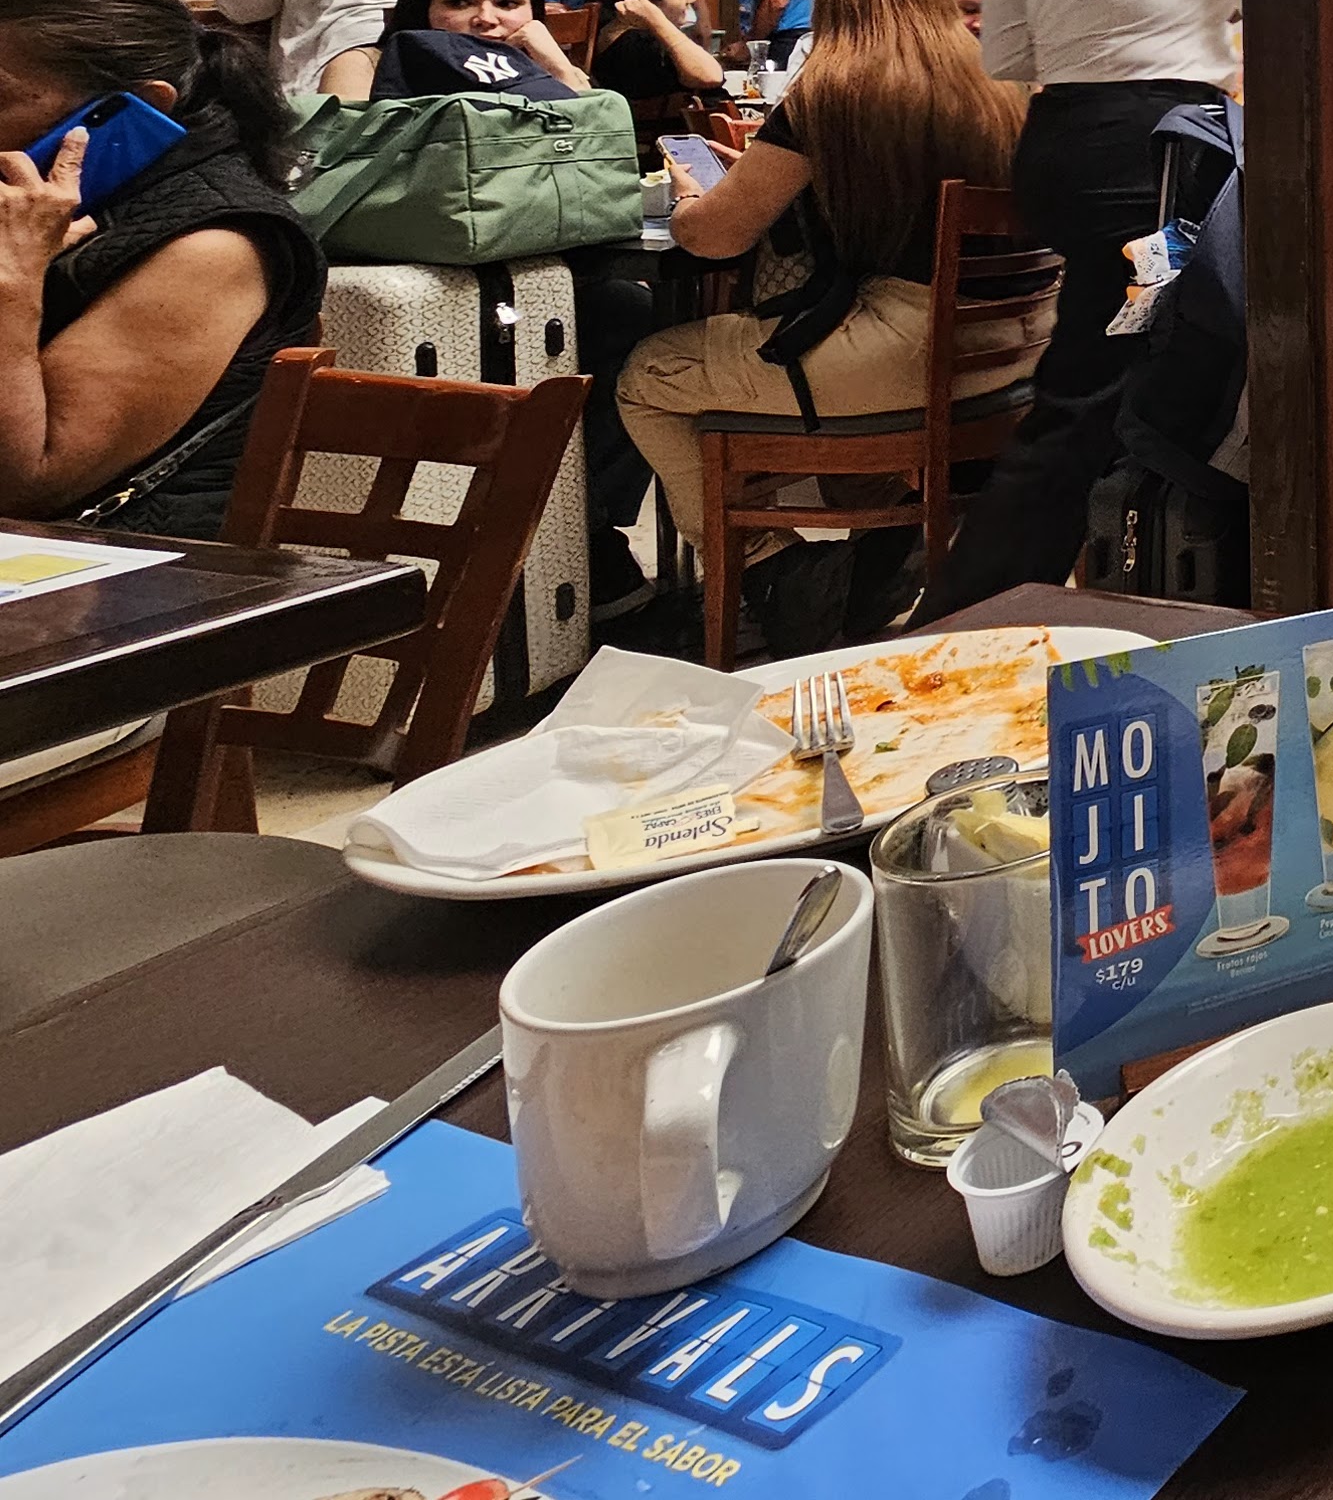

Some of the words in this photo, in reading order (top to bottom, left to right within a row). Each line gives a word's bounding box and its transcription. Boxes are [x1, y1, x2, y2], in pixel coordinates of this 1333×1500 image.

[463, 52, 520, 84] NY
[644, 818, 677, 831] CAPAZ
[695, 806, 722, 820] ERES
[645, 815, 733, 849] Splenda
[1088, 911, 1170, 960] LOVERS
[1095, 957, 1144, 984] $179
[1111, 975, 1137, 991] c/u
[400, 1226, 864, 1421] ARRIVALS
[323, 1310, 369, 1338] LA
[354, 1322, 430, 1363] PISTA
[416, 1347, 496, 1388] ESTÁ
[474, 1371, 551, 1411] LISTA
[541, 1395, 617, 1440] PARA
[607, 1421, 650, 1451] EL
[641, 1434, 741, 1488] SABOR
